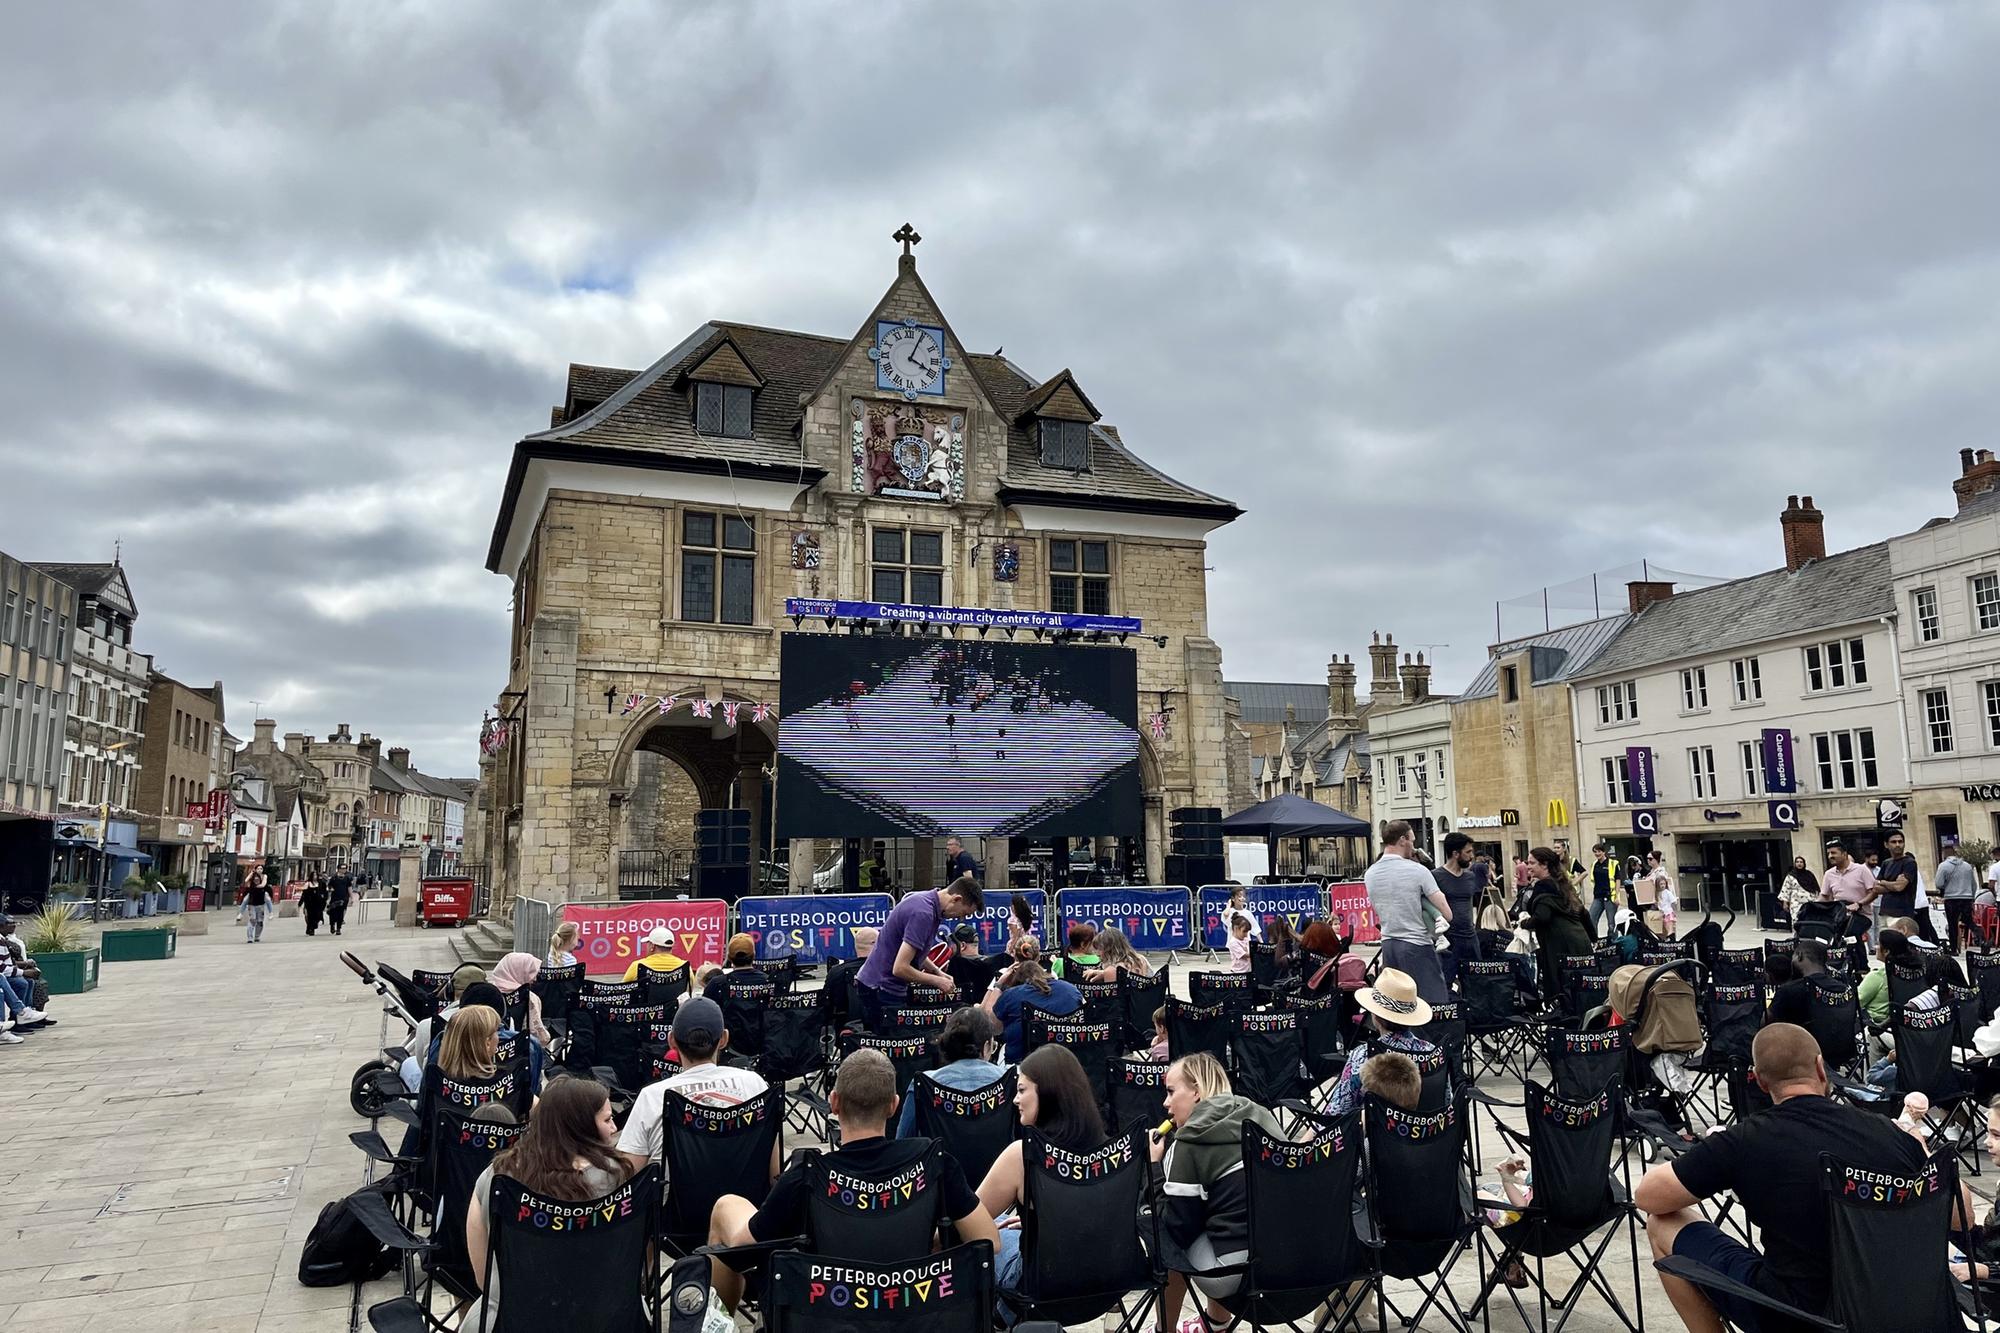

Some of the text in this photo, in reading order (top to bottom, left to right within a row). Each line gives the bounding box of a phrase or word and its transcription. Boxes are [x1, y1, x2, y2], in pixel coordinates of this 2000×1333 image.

[791, 605, 837, 614] POSITIVE
[879, 606, 1062, 626] Creating a vibrant city centre for all
[1776, 733, 1786, 787] Queensgate
[1638, 751, 1648, 798] Queensgate
[434, 893, 454, 903] Biffa
[1206, 898, 1315, 914] PEBOROUGH
[1335, 896, 1371, 910] PETERB
[1066, 903, 1184, 917] PETERBOROUGH
[746, 910, 886, 928] PETERBOROUGH
[1469, 966, 1510, 974] POSITIVE
[593, 982, 639, 991] PETERBOROUGH
[729, 983, 775, 992] PETERBOROUGH
[913, 987, 963, 995] PETERBOGH
[1074, 983, 1118, 991] ETERBOROUGH
[1201, 980, 1248, 988] POSITIVE
[579, 994, 631, 1002] PETERBOROUGH
[1084, 990, 1118, 998] SITIVE
[609, 1005, 664, 1014] PETERBOROUGH
[897, 1007, 952, 1017] PETERBOROUGH
[1431, 1003, 1458, 1012] OROUGH
[609, 1011, 664, 1023] POSITIVE
[1242, 1013, 1296, 1022] PETERBOROUGH
[1242, 1019, 1296, 1031] POSITIVE
[1904, 1012, 1951, 1029] POSITIVE
[1048, 1023, 1109, 1033] PETERBOROUGH
[1566, 1029, 1619, 1042] PETERBOROUGH
[860, 1037, 925, 1048] PETERBOROUGH
[1047, 1031, 1110, 1043] POSITIVE
[1567, 1037, 1620, 1052] POSITIVE
[882, 1045, 925, 1057] SITIVE
[1386, 1046, 1444, 1063] PRBOROUGH
[653, 1059, 684, 1073] PETERB
[1126, 1063, 1169, 1073] PETERBOR
[443, 1073, 514, 1095] PETERBOROUGH
[1125, 1072, 1167, 1086] POSIT
[442, 1081, 515, 1107] POSITIVE
[933, 1083, 1004, 1105] PETERBOROUGH
[684, 1098, 765, 1121] PETERBOROUGH
[933, 1091, 1006, 1117] POSITIVE
[683, 1108, 766, 1132] POSITIVE
[1542, 1099, 1609, 1127] POSITIVE
[462, 1121, 529, 1137] PETERBOR
[1387, 1111, 1455, 1139] POSITIVE
[460, 1130, 517, 1150] POSIT
[1262, 1126, 1342, 1156] PETERBOROUGH
[1045, 1134, 1131, 1165] PETERBOROUGH
[1261, 1136, 1345, 1169] POSITIVE
[1045, 1145, 1132, 1180] POSITIVE
[829, 1161, 925, 1194] PETERBOROUGH
[1845, 1162, 1938, 1189] PETERBORGH
[828, 1173, 926, 1210] POSITIVE
[1844, 1175, 1940, 1204] POSITIVE
[521, 1185, 632, 1217] PETERBOROUGH
[517, 1198, 633, 1231] POSITIVE
[810, 1258, 952, 1288] PETERBOROUGH
[810, 1274, 954, 1310] POSITIVE
